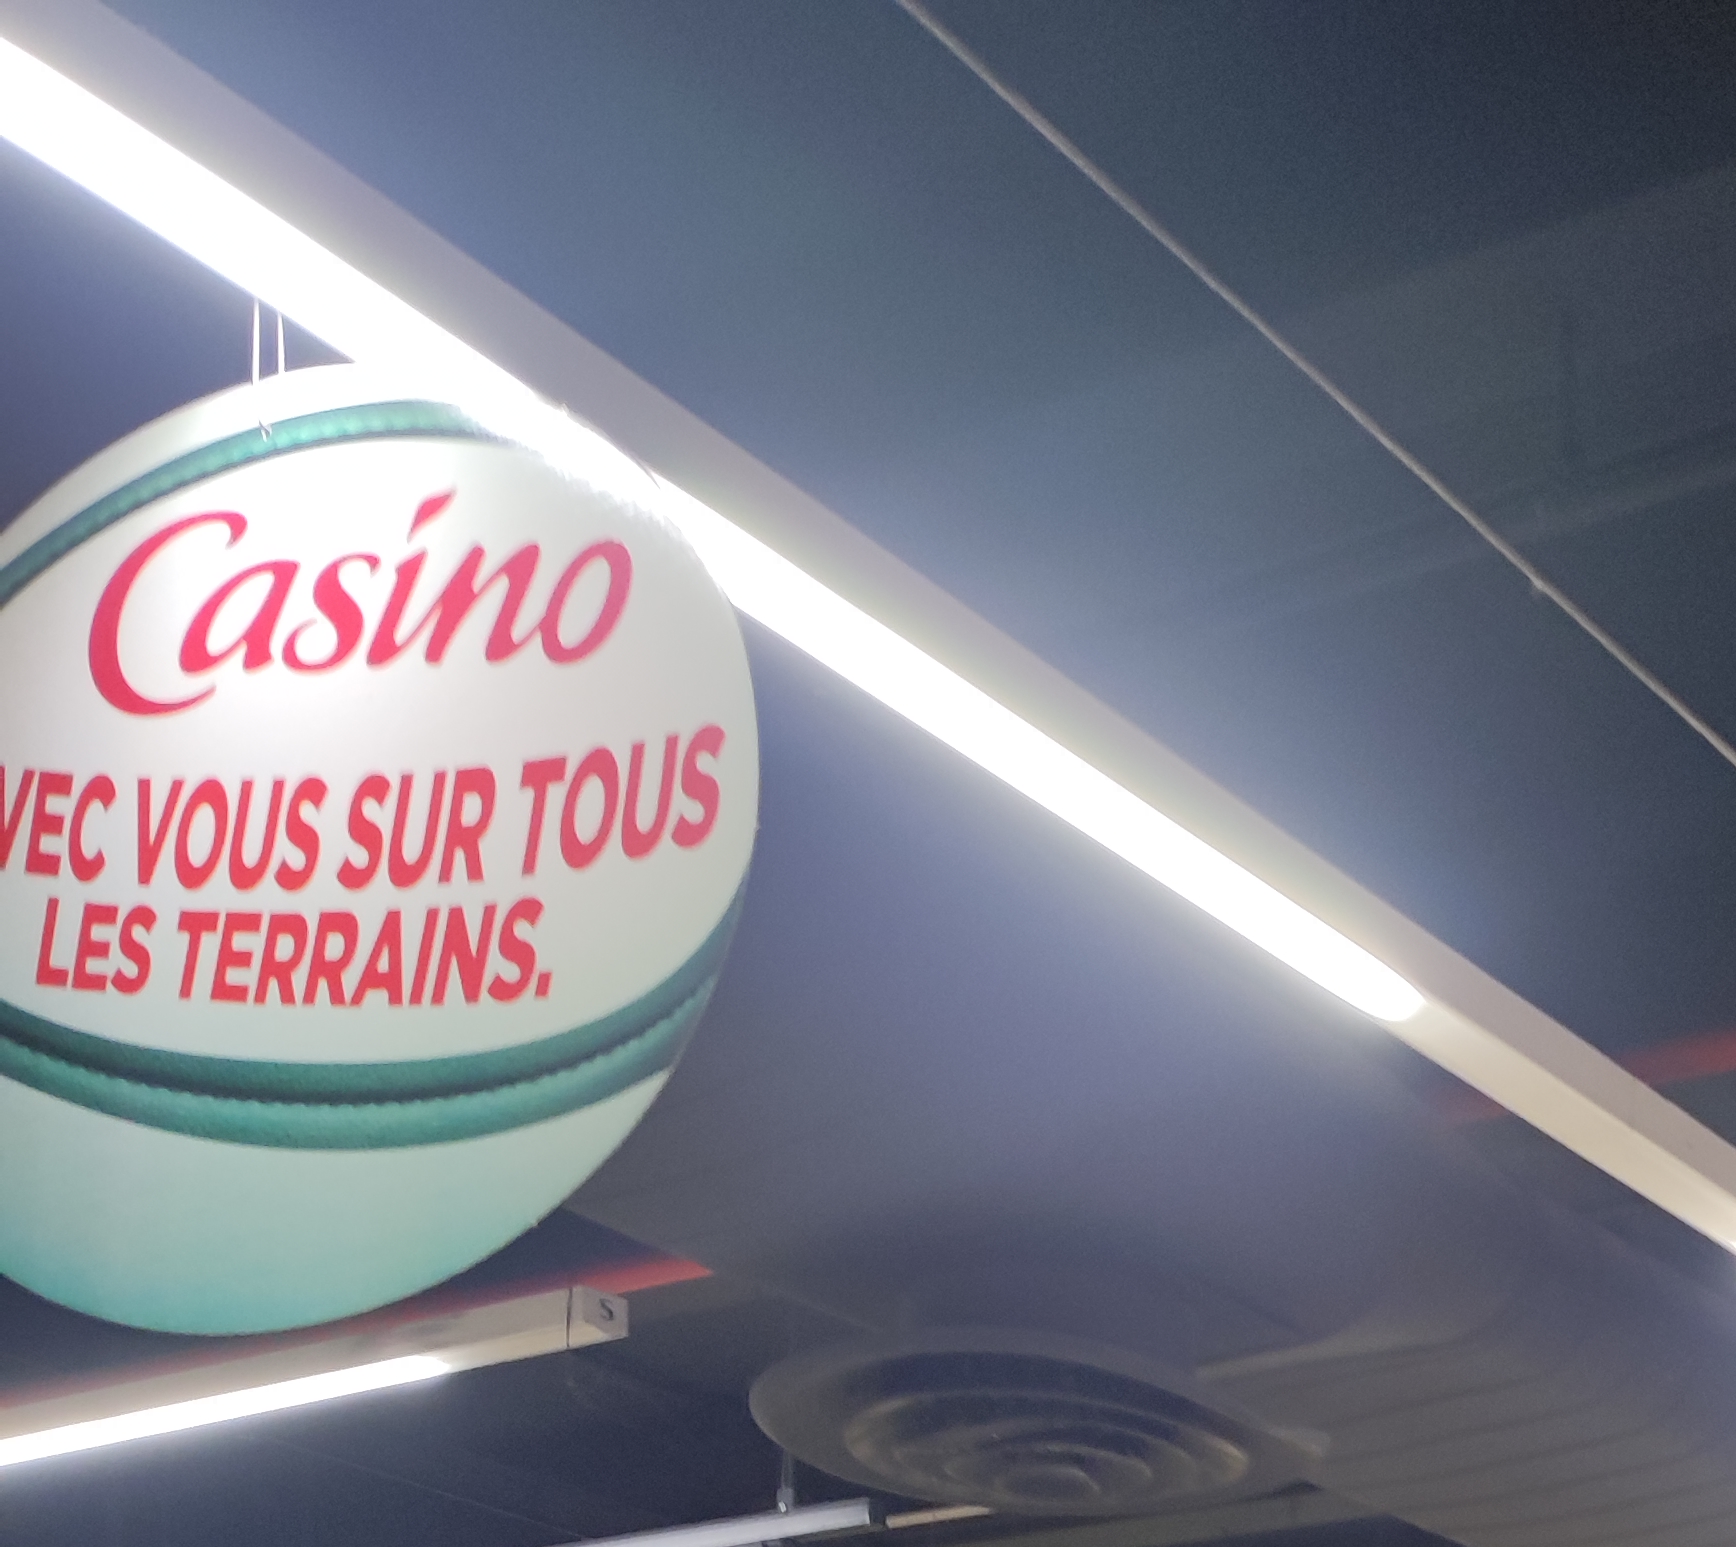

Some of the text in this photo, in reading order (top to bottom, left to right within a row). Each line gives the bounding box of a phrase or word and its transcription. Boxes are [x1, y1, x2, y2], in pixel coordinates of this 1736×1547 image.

[88, 489, 633, 716] Casino
[0, 723, 726, 891] VEC VOUS SUR TOUS
[34, 897, 554, 1008] LES TERRAINS.
